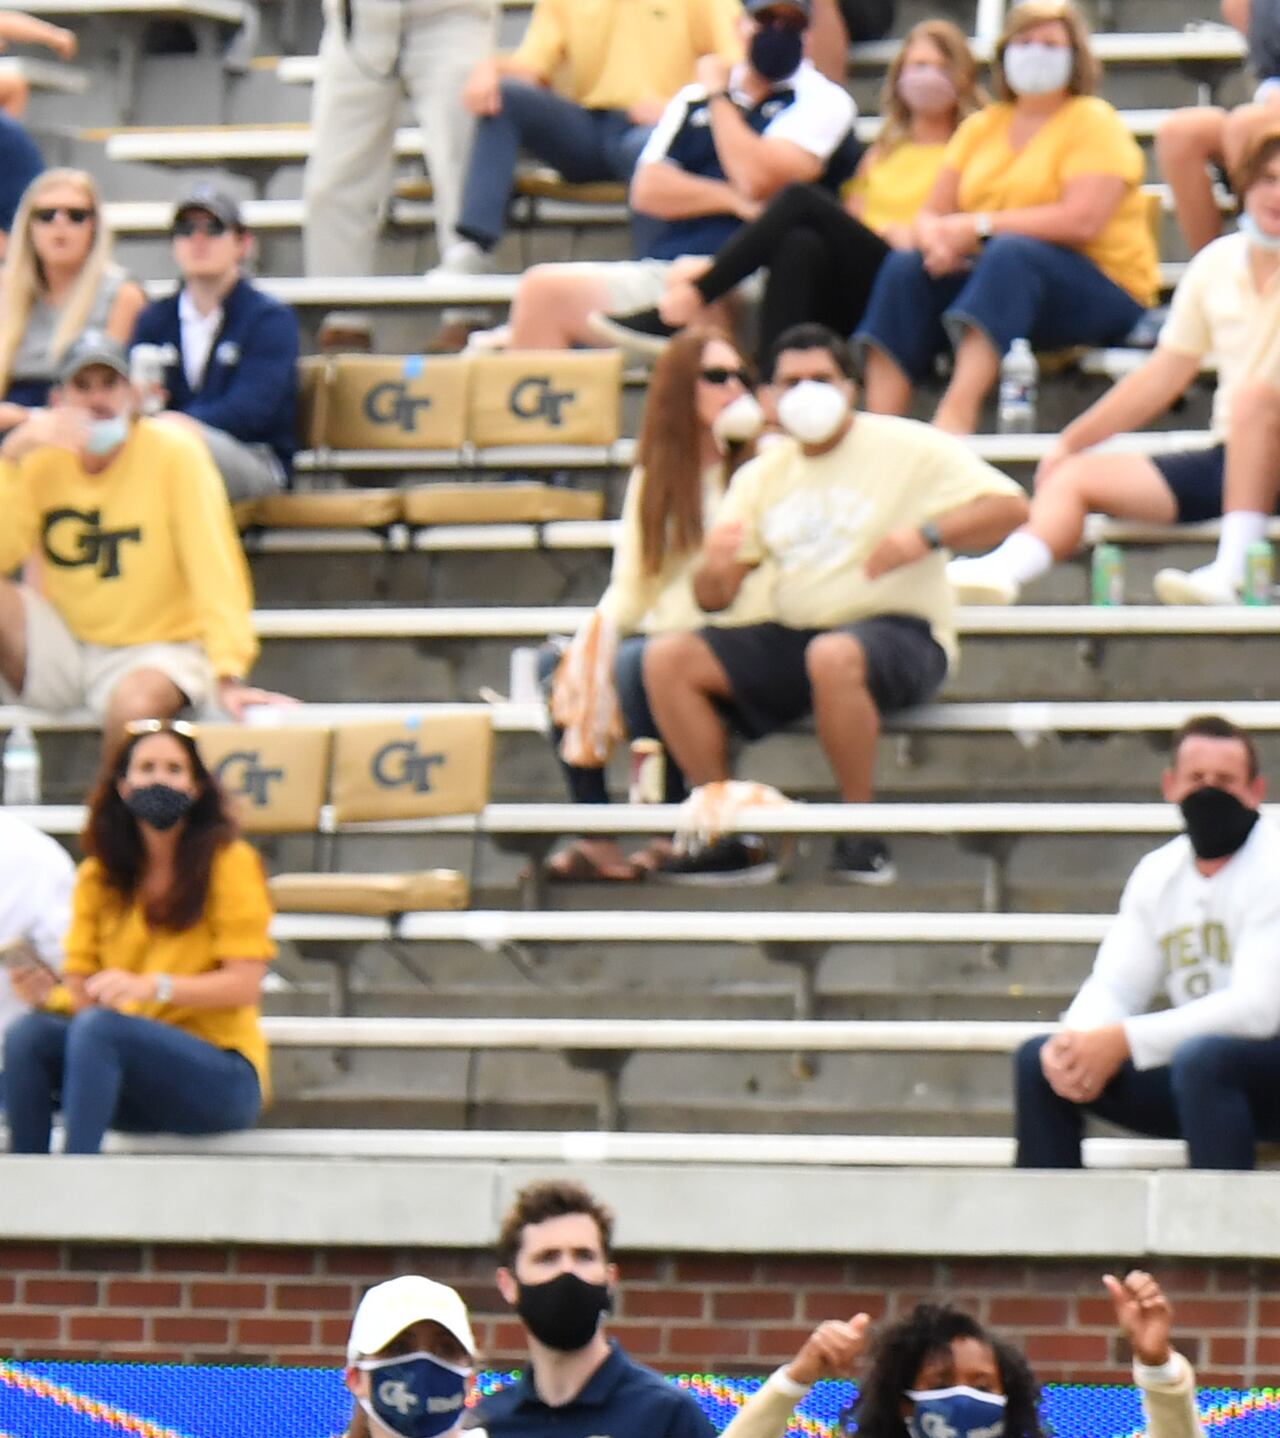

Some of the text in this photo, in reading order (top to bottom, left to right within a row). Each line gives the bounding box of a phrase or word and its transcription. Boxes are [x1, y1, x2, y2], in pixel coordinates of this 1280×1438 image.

[363, 381, 430, 430] GT
[508, 377, 575, 426] GT
[41, 506, 142, 580] GT
[370, 741, 446, 793] GT
